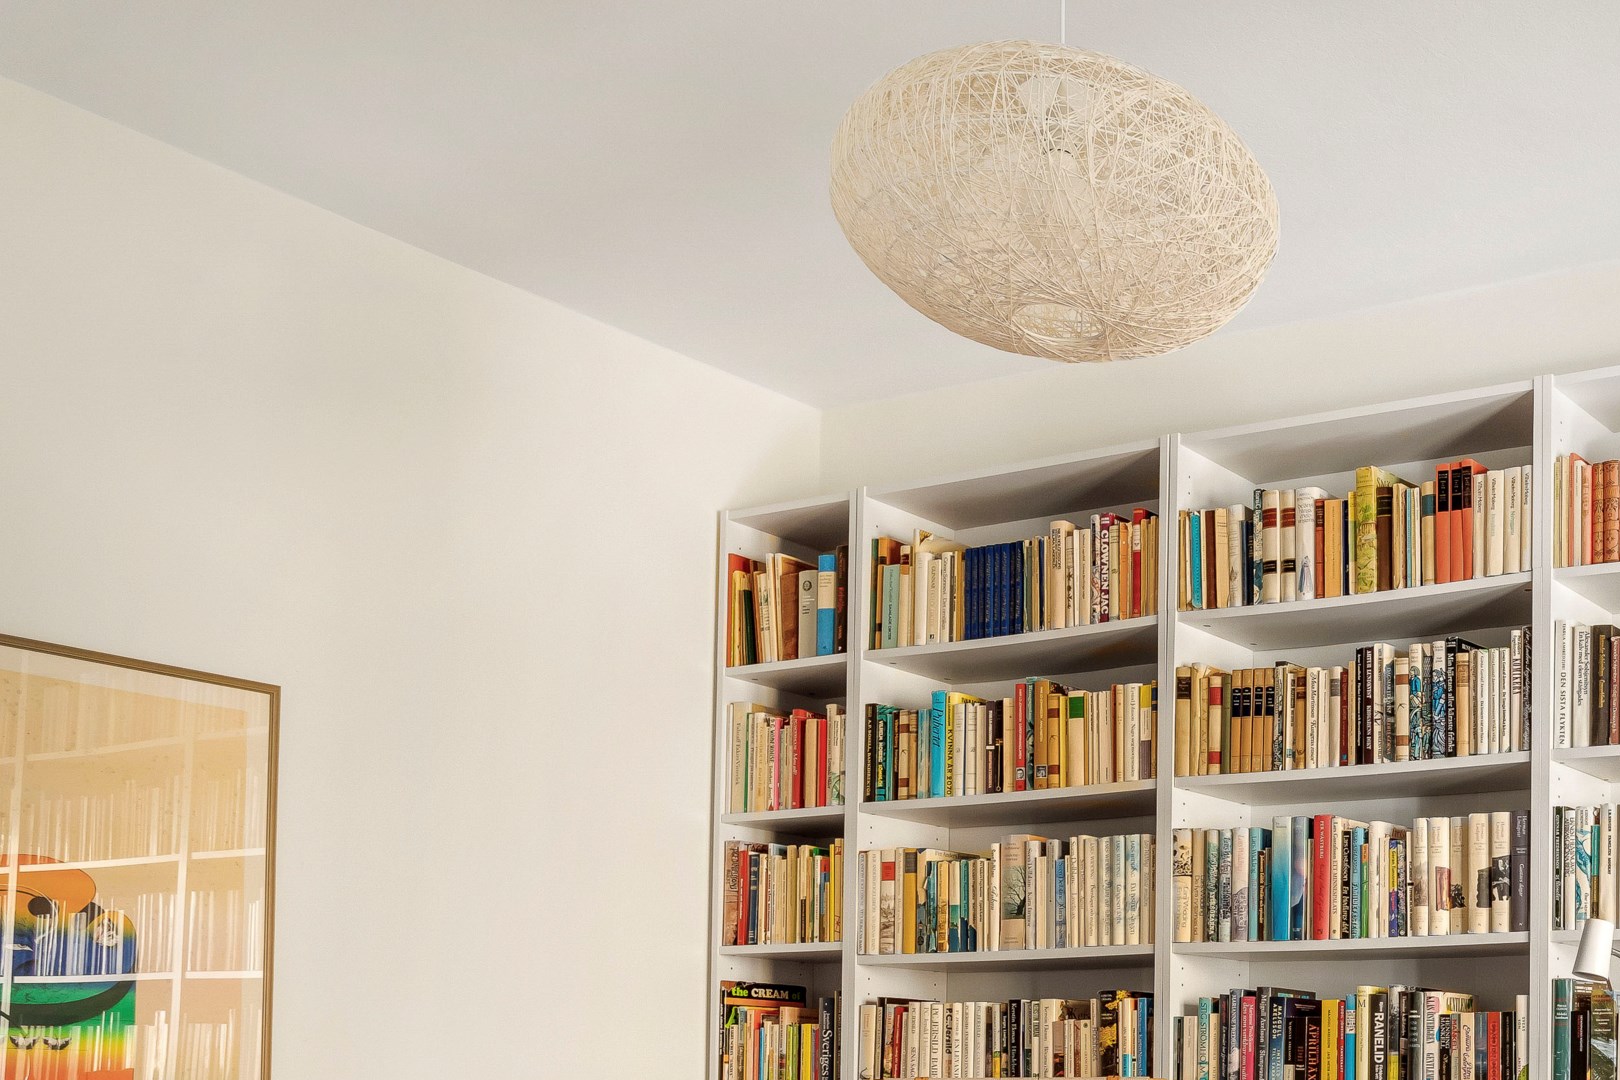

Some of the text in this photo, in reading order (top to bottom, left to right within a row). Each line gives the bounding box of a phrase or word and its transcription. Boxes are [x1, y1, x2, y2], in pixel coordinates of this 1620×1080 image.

[1100, 530, 1109, 614] CLOWNEN JAC
[1445, 653, 1455, 752] Min hjärtans aller käraste fränka
[932, 707, 944, 747] Pubertet
[946, 763, 954, 773] ÅR
[732, 988, 748, 996] the
[751, 988, 789, 999] CREAM
[1259, 994, 1267, 1017] Majgull
[819, 1030, 833, 1075] Sveriges
[1374, 1012, 1385, 1063] RANELID
[1451, 1019, 1459, 1053] MANKELL
